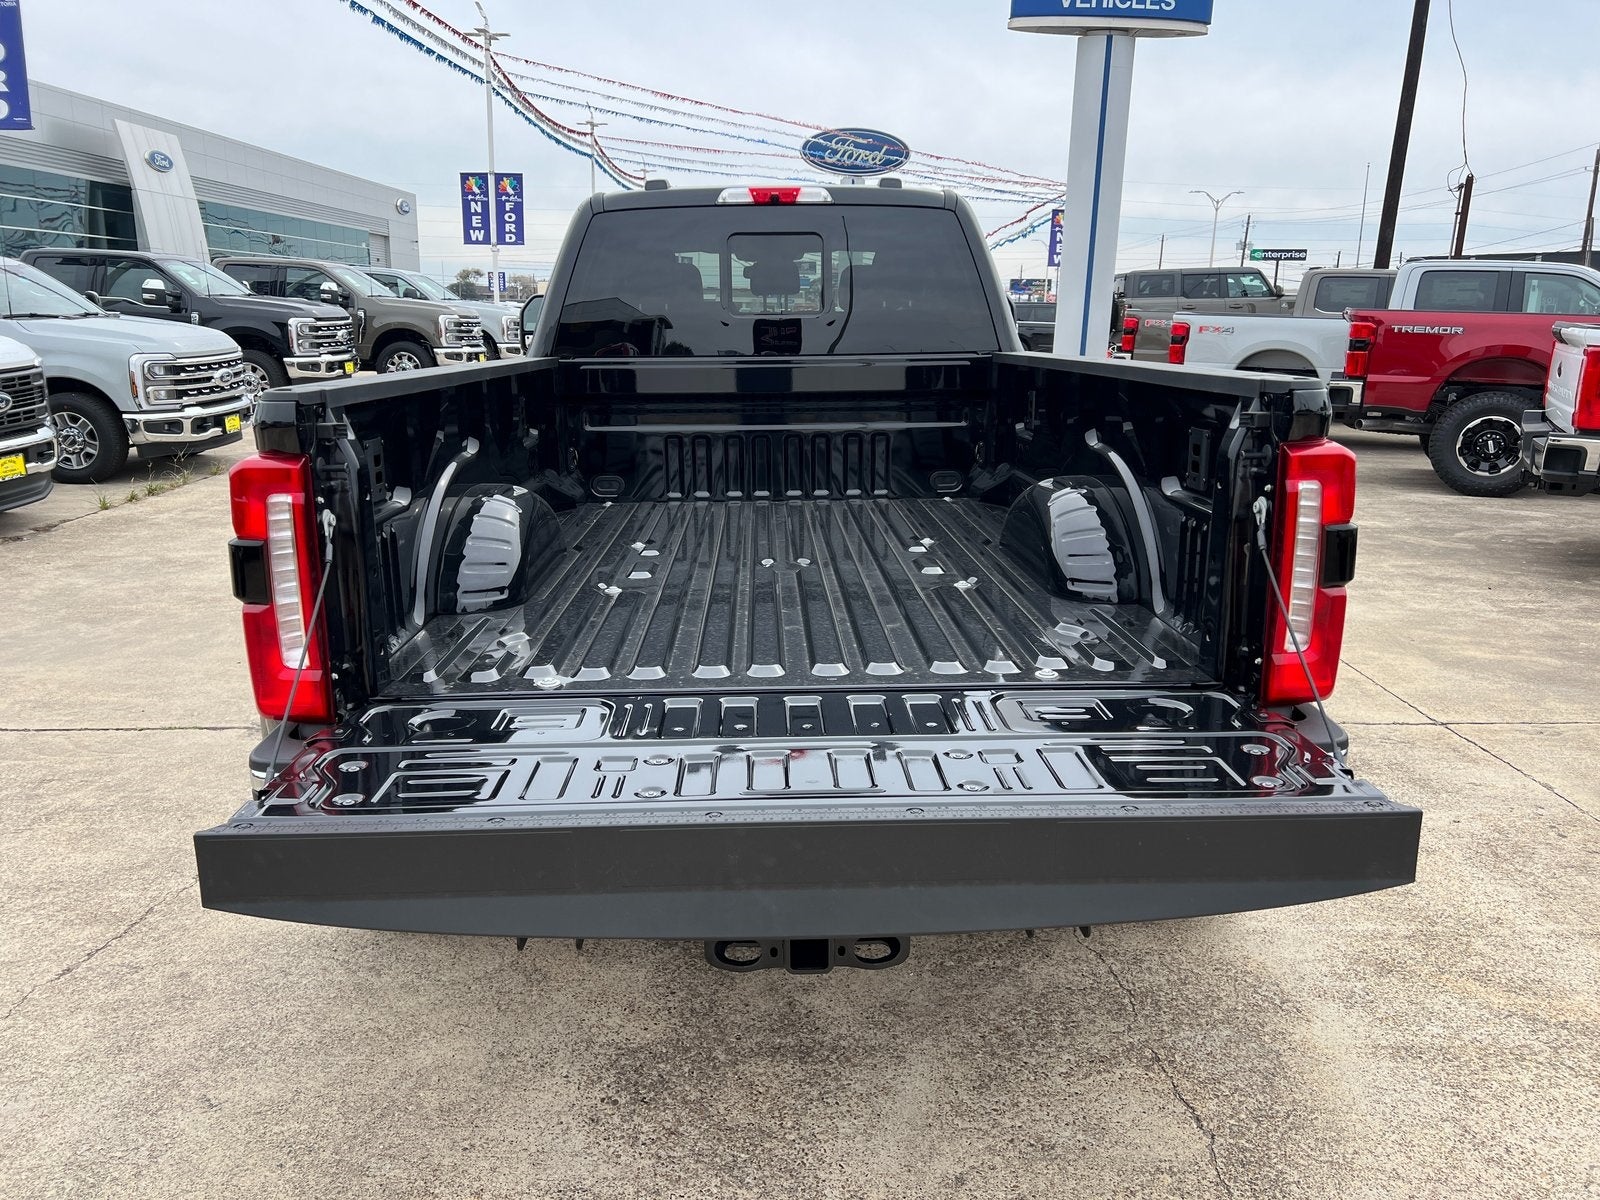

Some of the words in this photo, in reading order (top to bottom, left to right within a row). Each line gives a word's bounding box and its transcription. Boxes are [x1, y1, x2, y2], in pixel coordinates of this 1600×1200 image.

[1061, 0, 1176, 10] VEHICLES
[824, 137, 888, 164] Ford
[154, 153, 170, 168] Ford
[470, 201, 485, 241] NEW
[504, 202, 516, 243] FORD
[1252, 250, 1307, 259] enterprise
[1391, 325, 1464, 335] TREMOR
